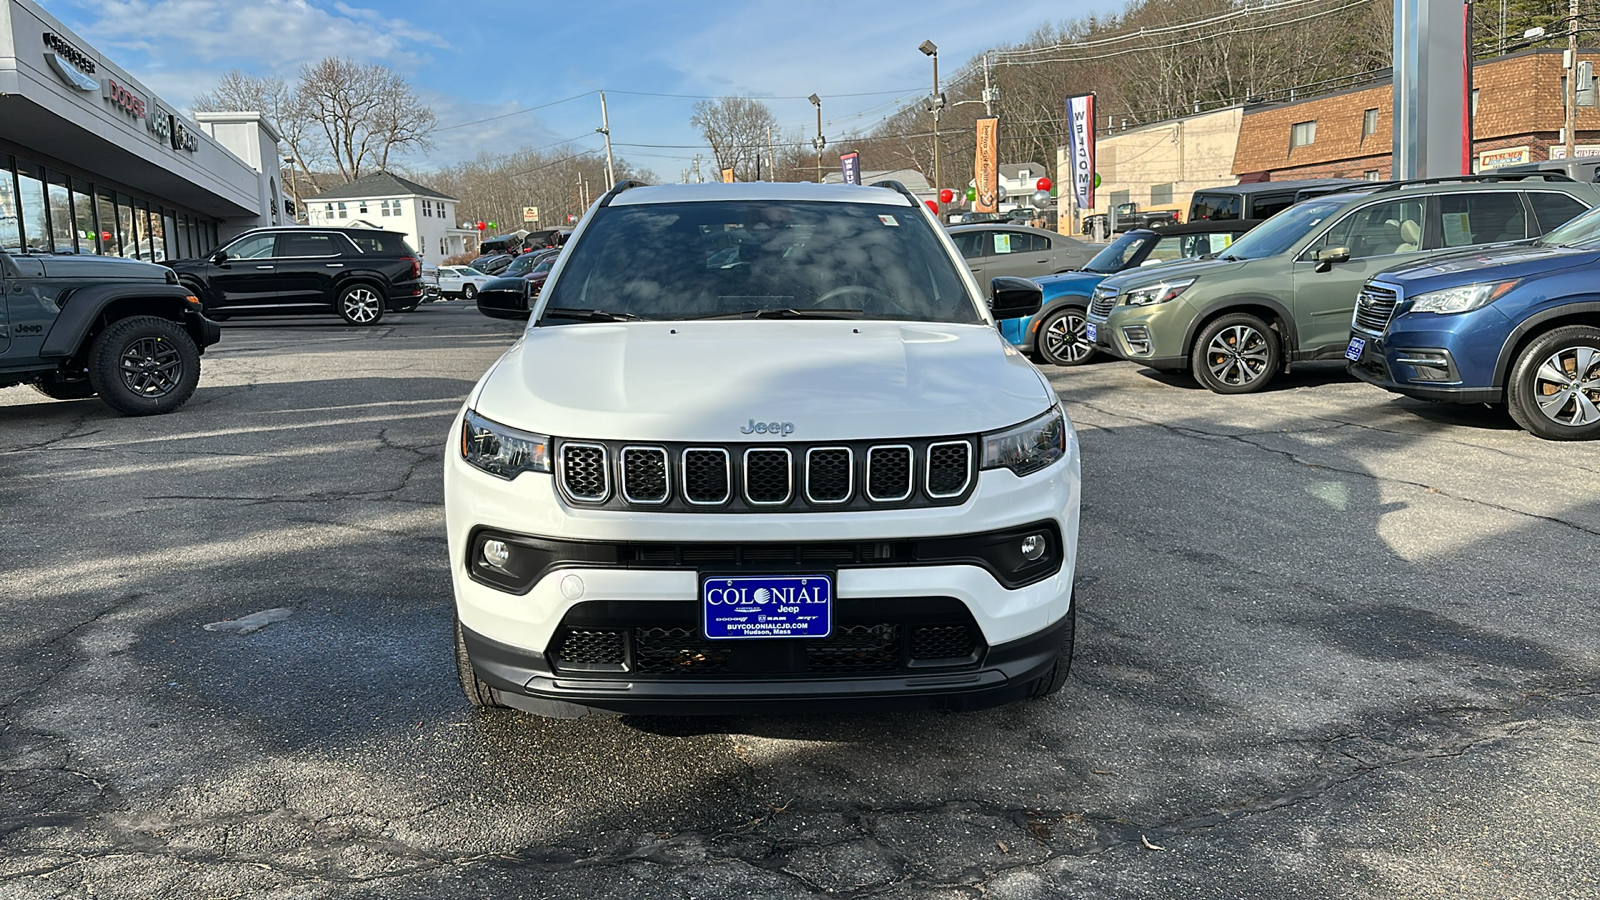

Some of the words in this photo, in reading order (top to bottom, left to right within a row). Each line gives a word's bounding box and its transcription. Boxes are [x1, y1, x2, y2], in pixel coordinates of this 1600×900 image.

[107, 79, 146, 119] DODGE
[150, 98, 172, 140] Jeep
[1482, 151, 1523, 166] CONSUMER
[15, 324, 42, 333] Jeep
[740, 419, 795, 437] Jeep
[707, 587, 827, 605] COLONIAL
[777, 605, 799, 613] Jeep
